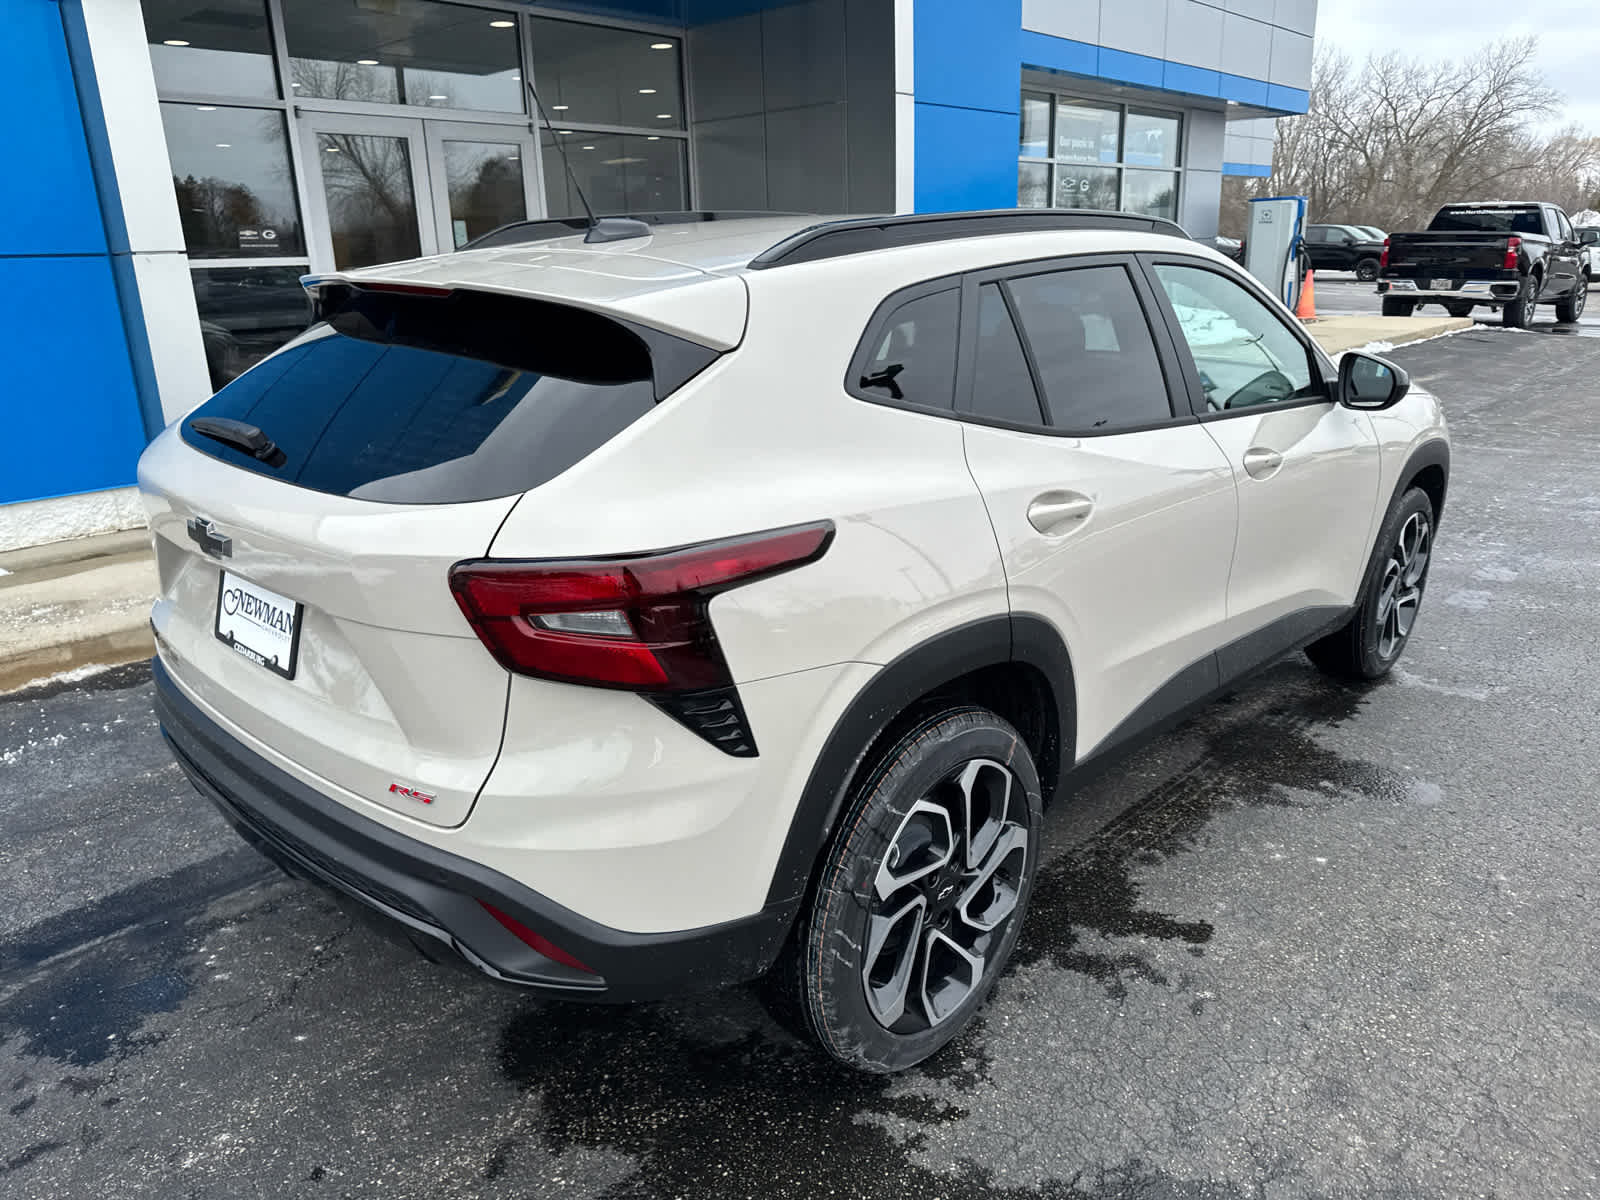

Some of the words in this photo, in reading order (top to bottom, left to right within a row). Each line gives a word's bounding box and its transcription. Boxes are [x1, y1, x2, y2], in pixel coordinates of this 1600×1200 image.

[262, 229, 276, 240] G
[223, 587, 294, 636] NEWMAN
[388, 783, 433, 804] RS
